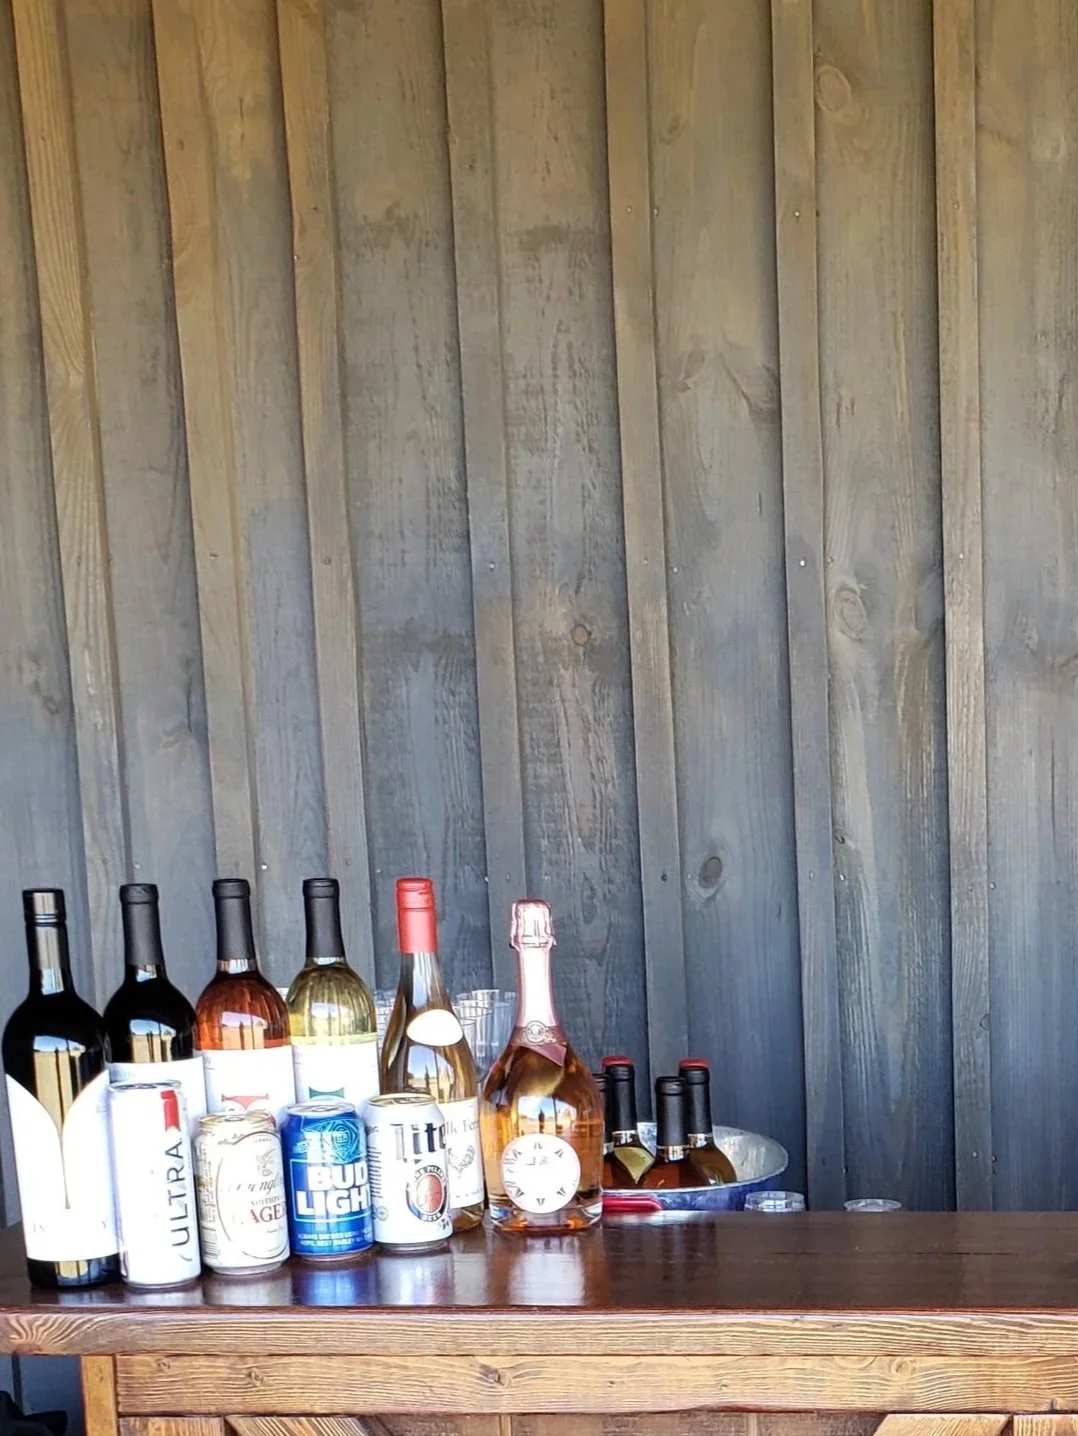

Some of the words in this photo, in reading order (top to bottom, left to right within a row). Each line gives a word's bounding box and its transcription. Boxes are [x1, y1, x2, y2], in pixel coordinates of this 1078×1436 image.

[307, 1160, 367, 1191] BUD
[165, 1141, 190, 1247] ULTRA
[296, 1184, 371, 1215] LIGH
[235, 1201, 287, 1224] AGE
